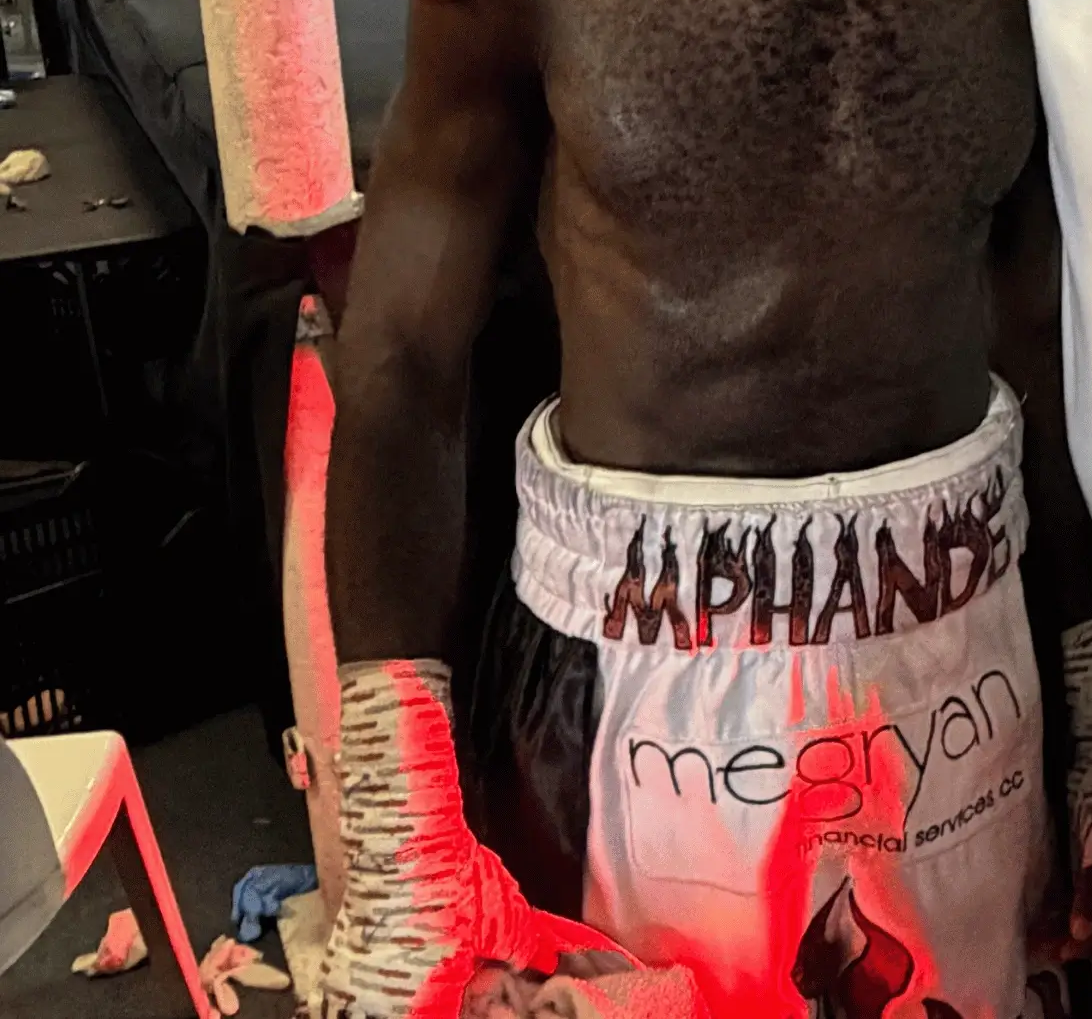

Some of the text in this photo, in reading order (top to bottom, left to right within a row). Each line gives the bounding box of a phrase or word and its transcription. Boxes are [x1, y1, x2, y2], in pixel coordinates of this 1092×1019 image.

[629, 670, 1022, 824] megryan
[914, 789, 995, 848] services
[999, 769, 1025, 798] cc
